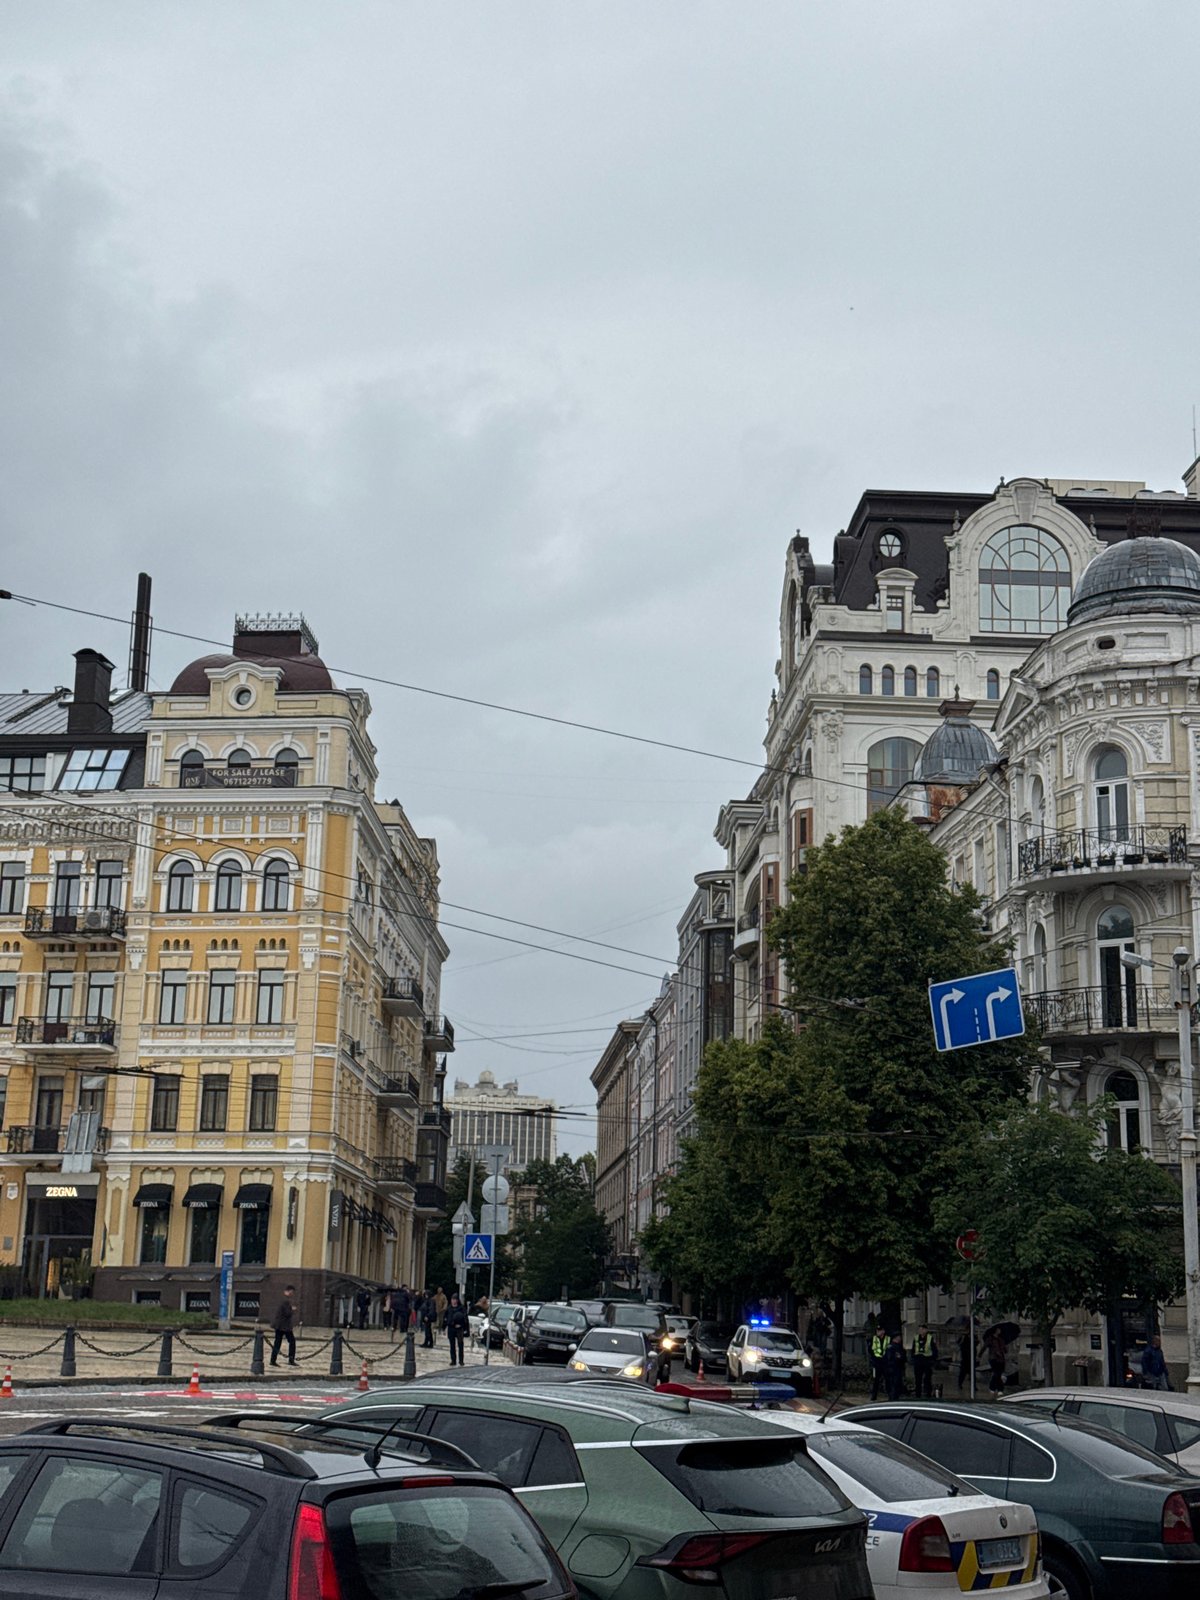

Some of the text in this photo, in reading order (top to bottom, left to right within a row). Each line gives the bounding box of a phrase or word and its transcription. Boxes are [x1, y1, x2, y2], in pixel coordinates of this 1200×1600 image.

[45, 1186, 78, 1197] ZEGNA
[331, 1204, 340, 1228] ZEGNA
[239, 1300, 260, 1308] ZEGNA
